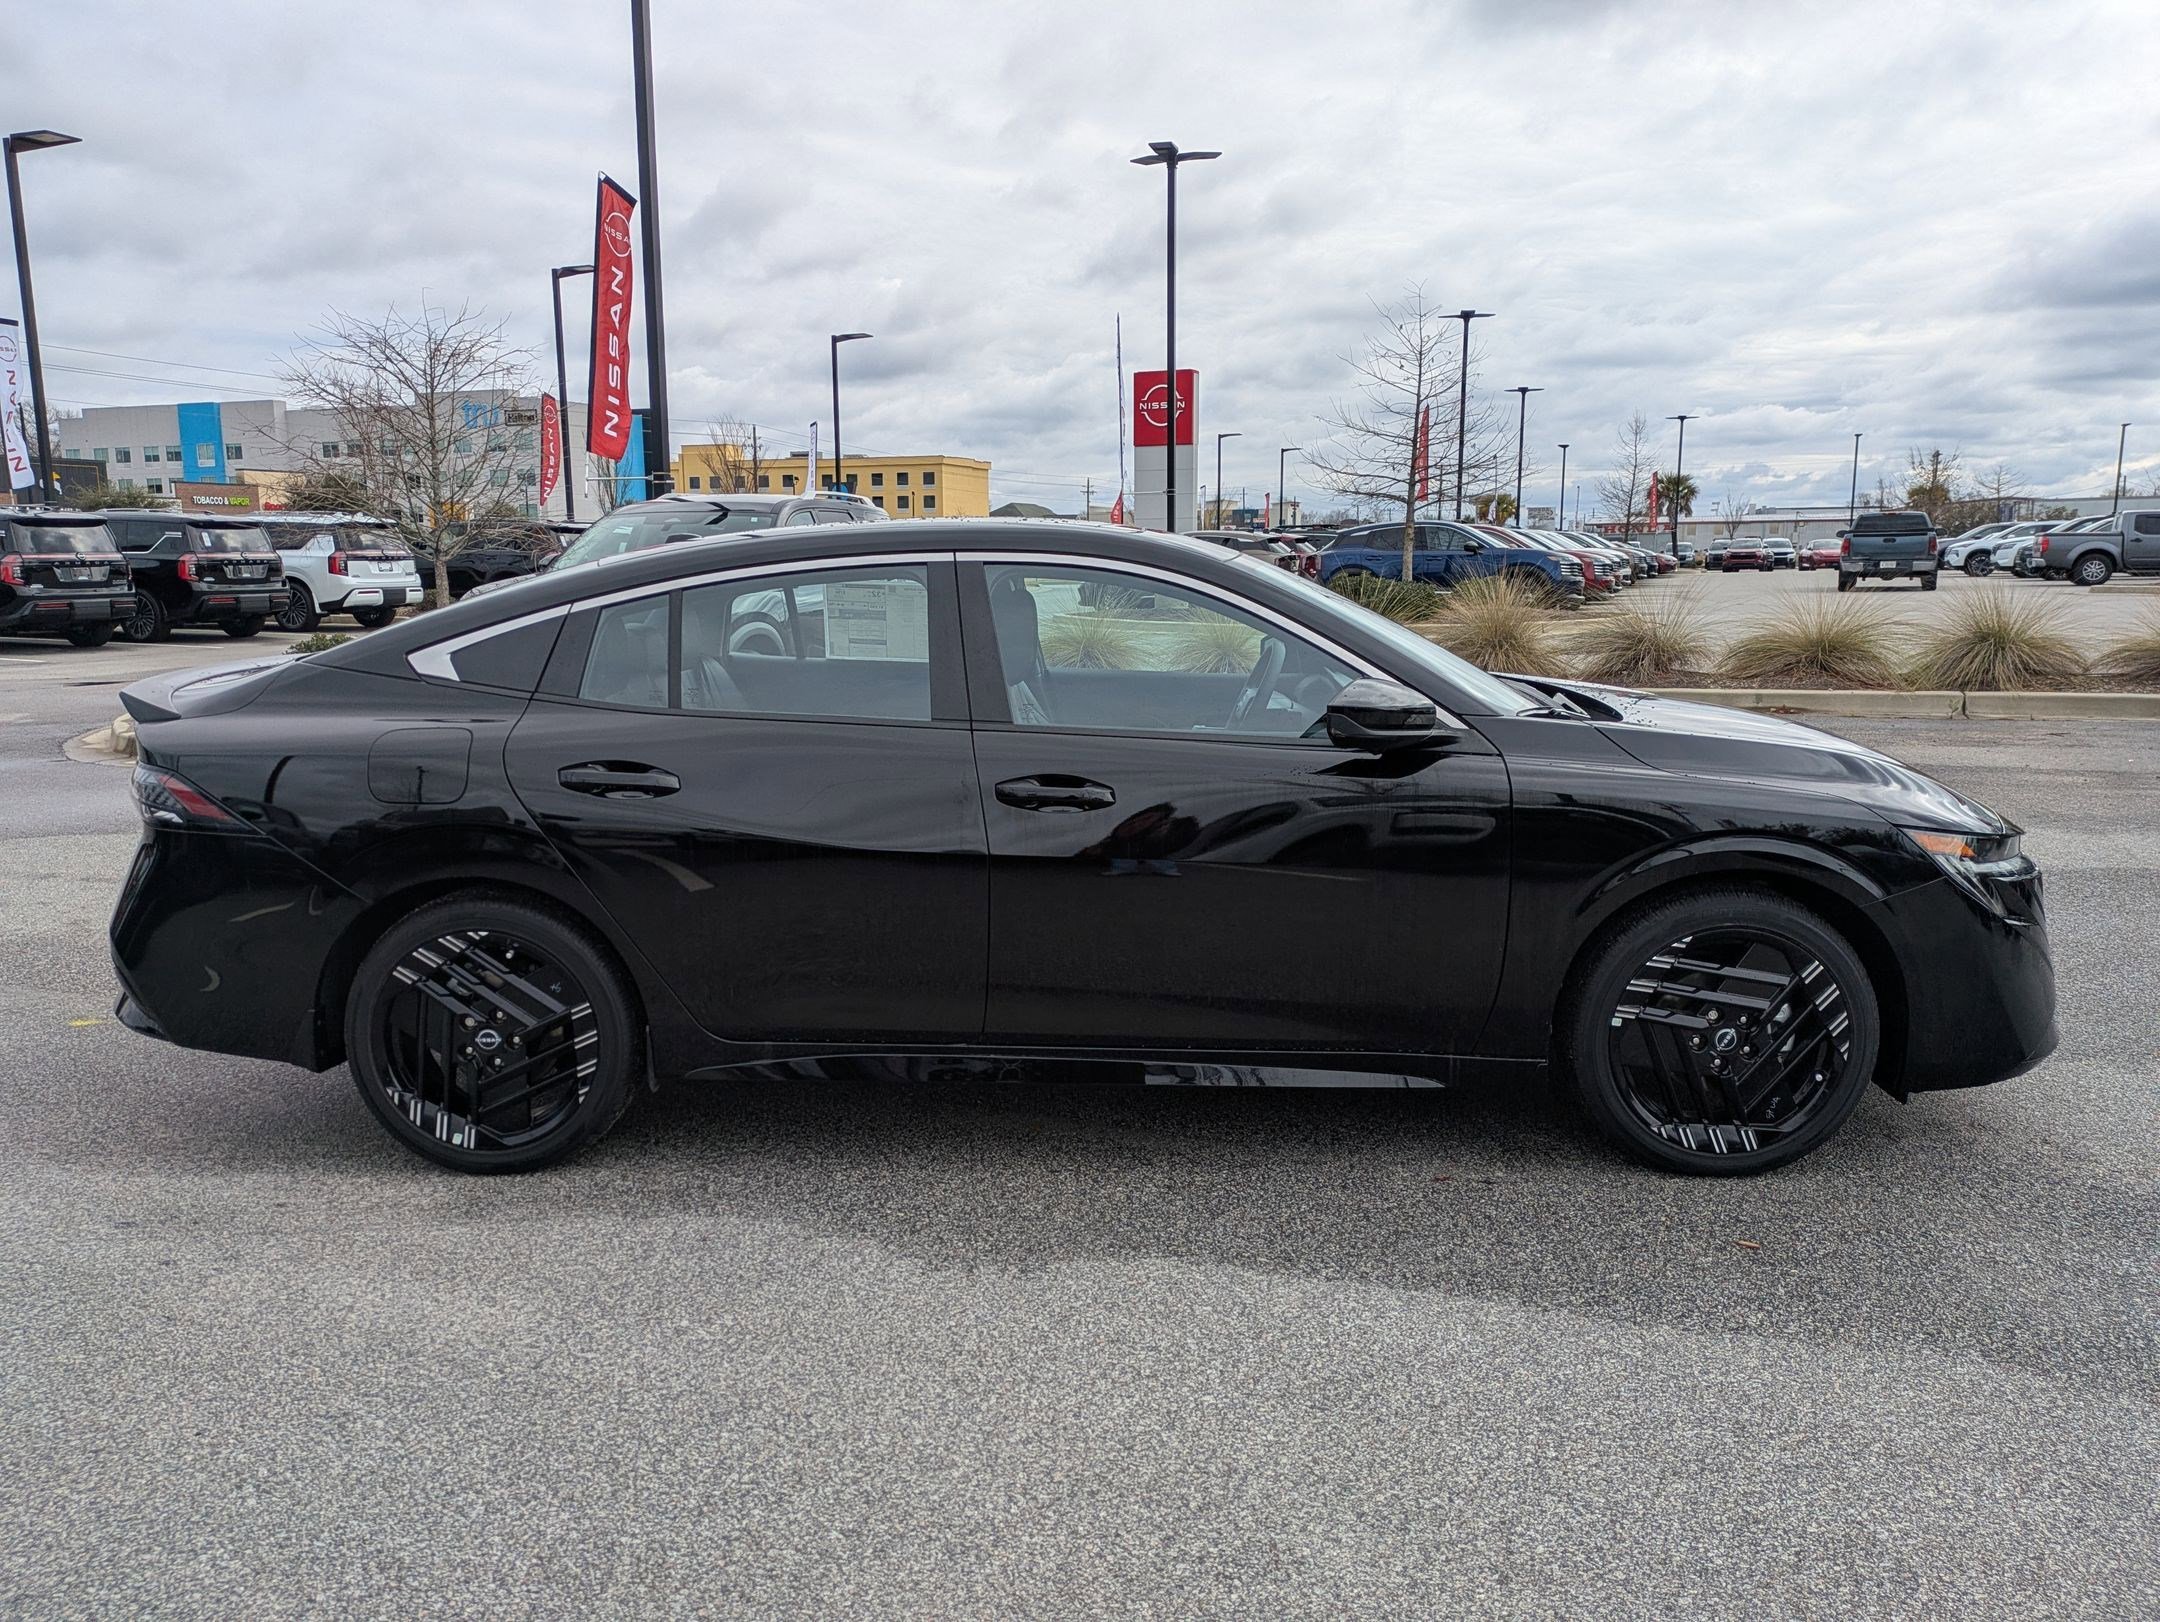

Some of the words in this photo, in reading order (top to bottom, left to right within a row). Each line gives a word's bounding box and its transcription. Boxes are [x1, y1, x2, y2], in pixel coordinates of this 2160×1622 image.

[604, 222, 630, 245] NISSA
[604, 265, 624, 438] NISSAN
[1139, 401, 1185, 410] NISSN
[193, 496, 223, 505] TOBACCO
[224, 497, 229, 505] &
[229, 497, 250, 506] VAPOR
